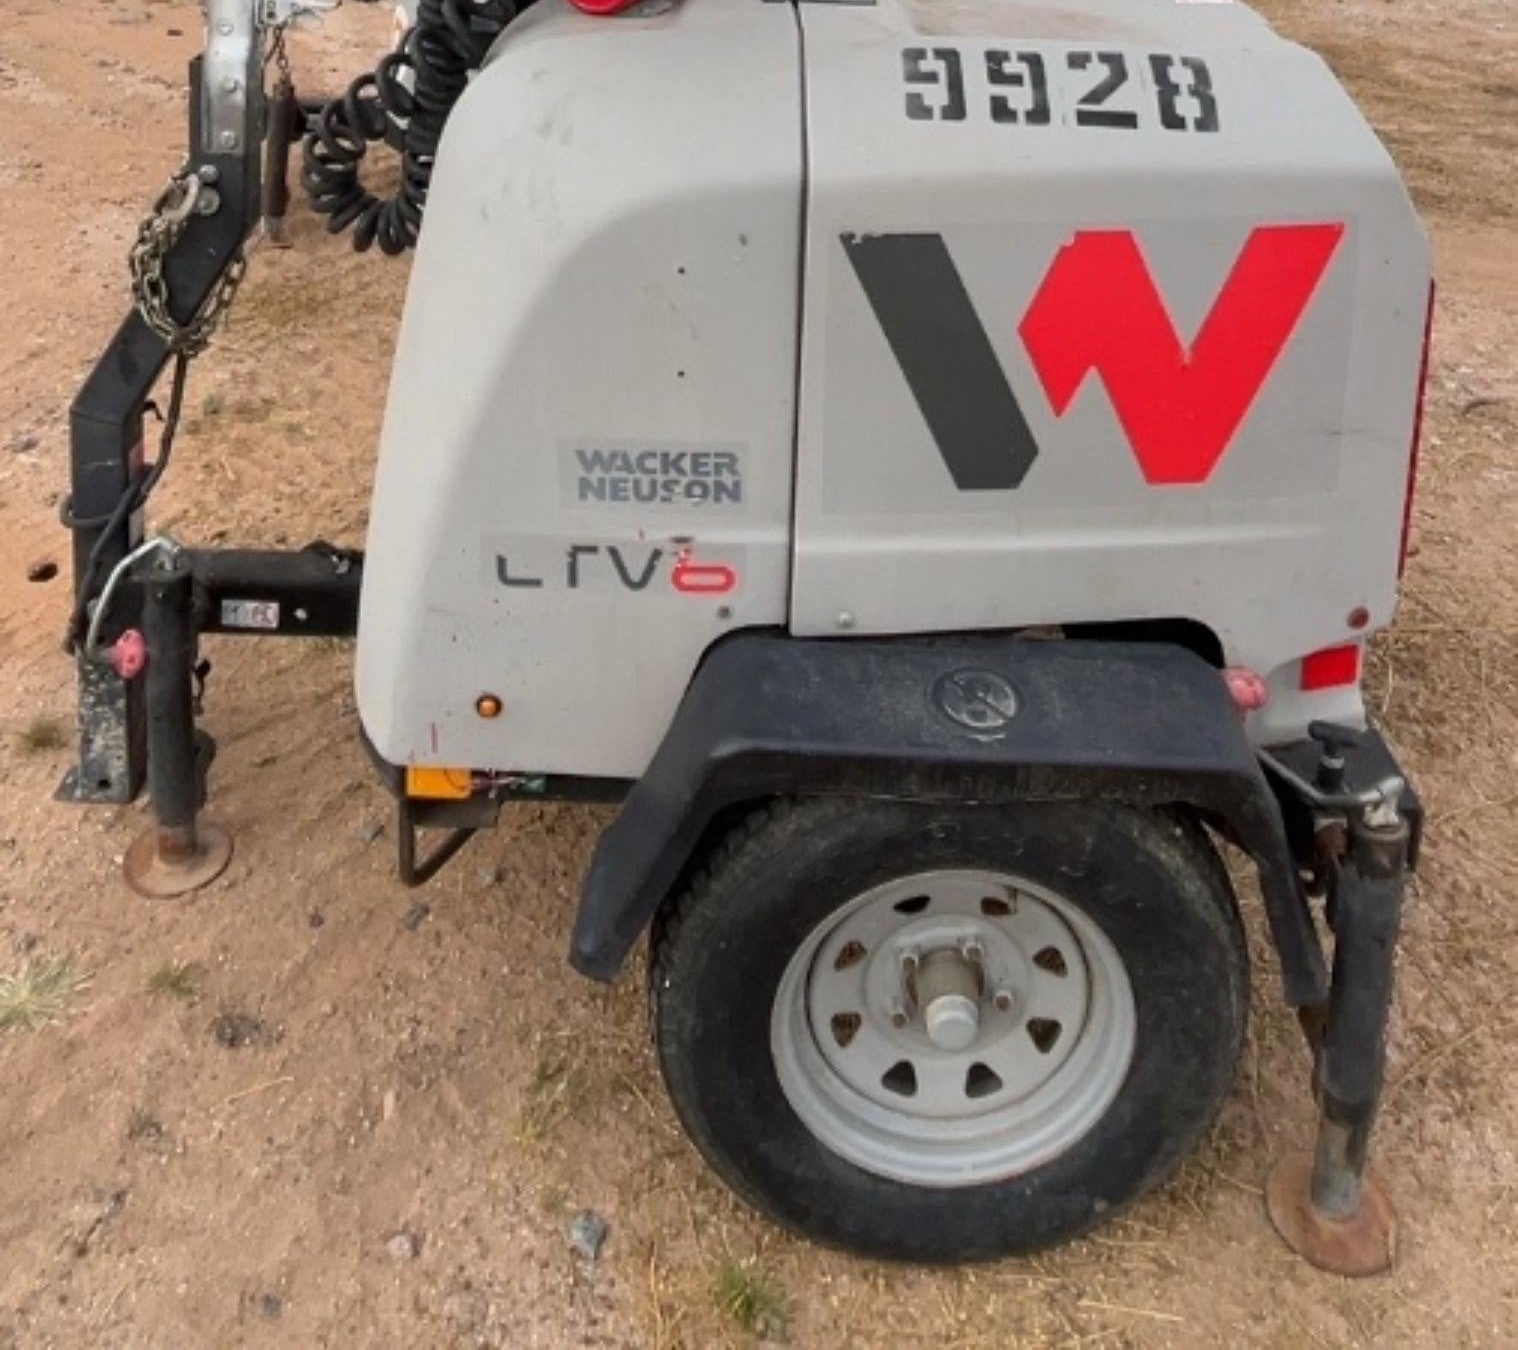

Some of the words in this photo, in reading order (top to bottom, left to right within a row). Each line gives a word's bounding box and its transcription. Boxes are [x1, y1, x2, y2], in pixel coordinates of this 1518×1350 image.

[902, 47, 1219, 132] 9928
[576, 450, 739, 477] WACKER
[578, 476, 742, 504] NEUSON
